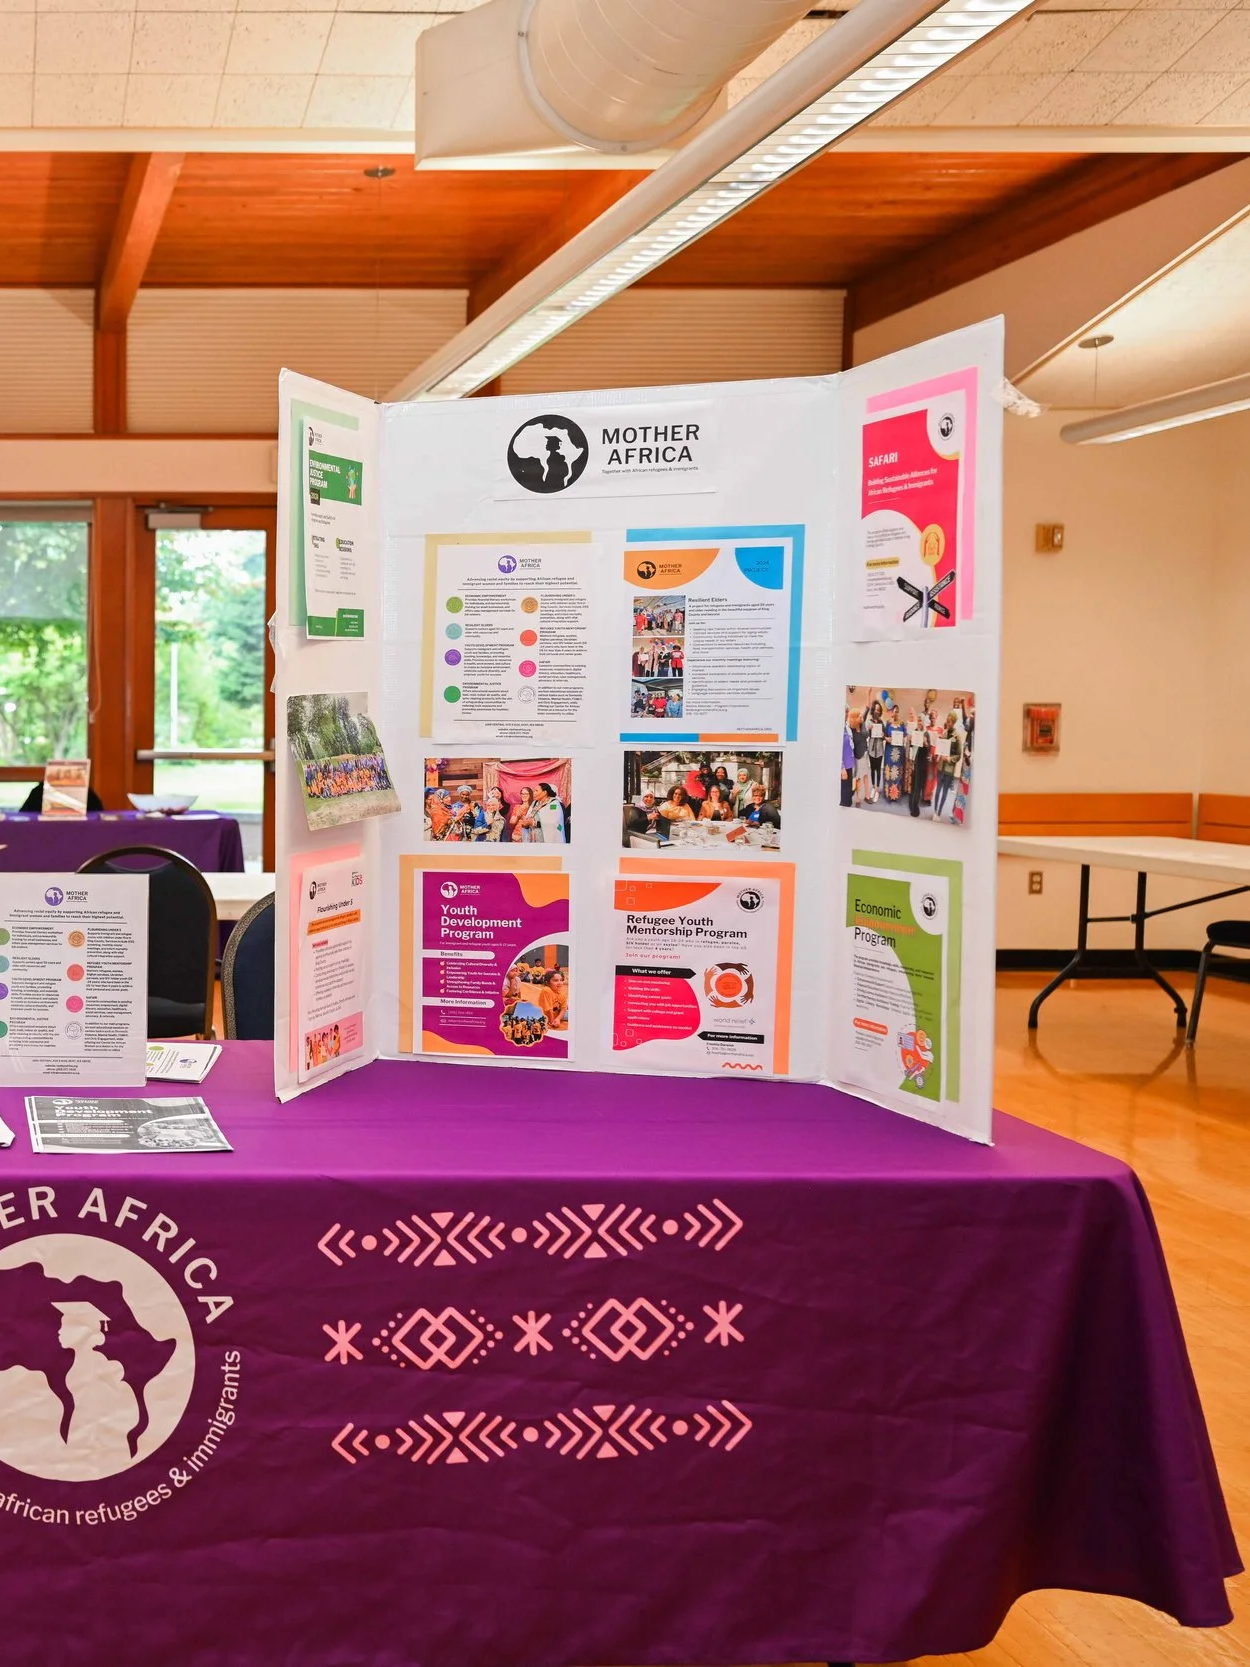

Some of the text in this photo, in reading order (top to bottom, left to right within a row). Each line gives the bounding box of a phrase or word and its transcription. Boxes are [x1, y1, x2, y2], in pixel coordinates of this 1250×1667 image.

[602, 424, 700, 445] MOTHER
[607, 445, 693, 465] AFRICA
[868, 451, 899, 468] SAFARI
[929, 467, 938, 475] for
[867, 487, 883, 496] African
[883, 484, 904, 494] Refugees
[908, 479, 934, 489] Immigrants
[317, 903, 338, 913] Flourishing
[440, 904, 477, 915] Youth
[855, 898, 902, 920] Economic
[440, 916, 522, 929] Development
[627, 914, 713, 926] Refugee Youth
[440, 927, 494, 940] Program
[626, 925, 747, 940] Mentorship Program
[854, 926, 896, 948] Program
[77, 1187, 234, 1324] AFRICA
[75, 1483, 172, 1525] refugees
[168, 1466, 193, 1489] &
[183, 1350, 241, 1473] immigrants
